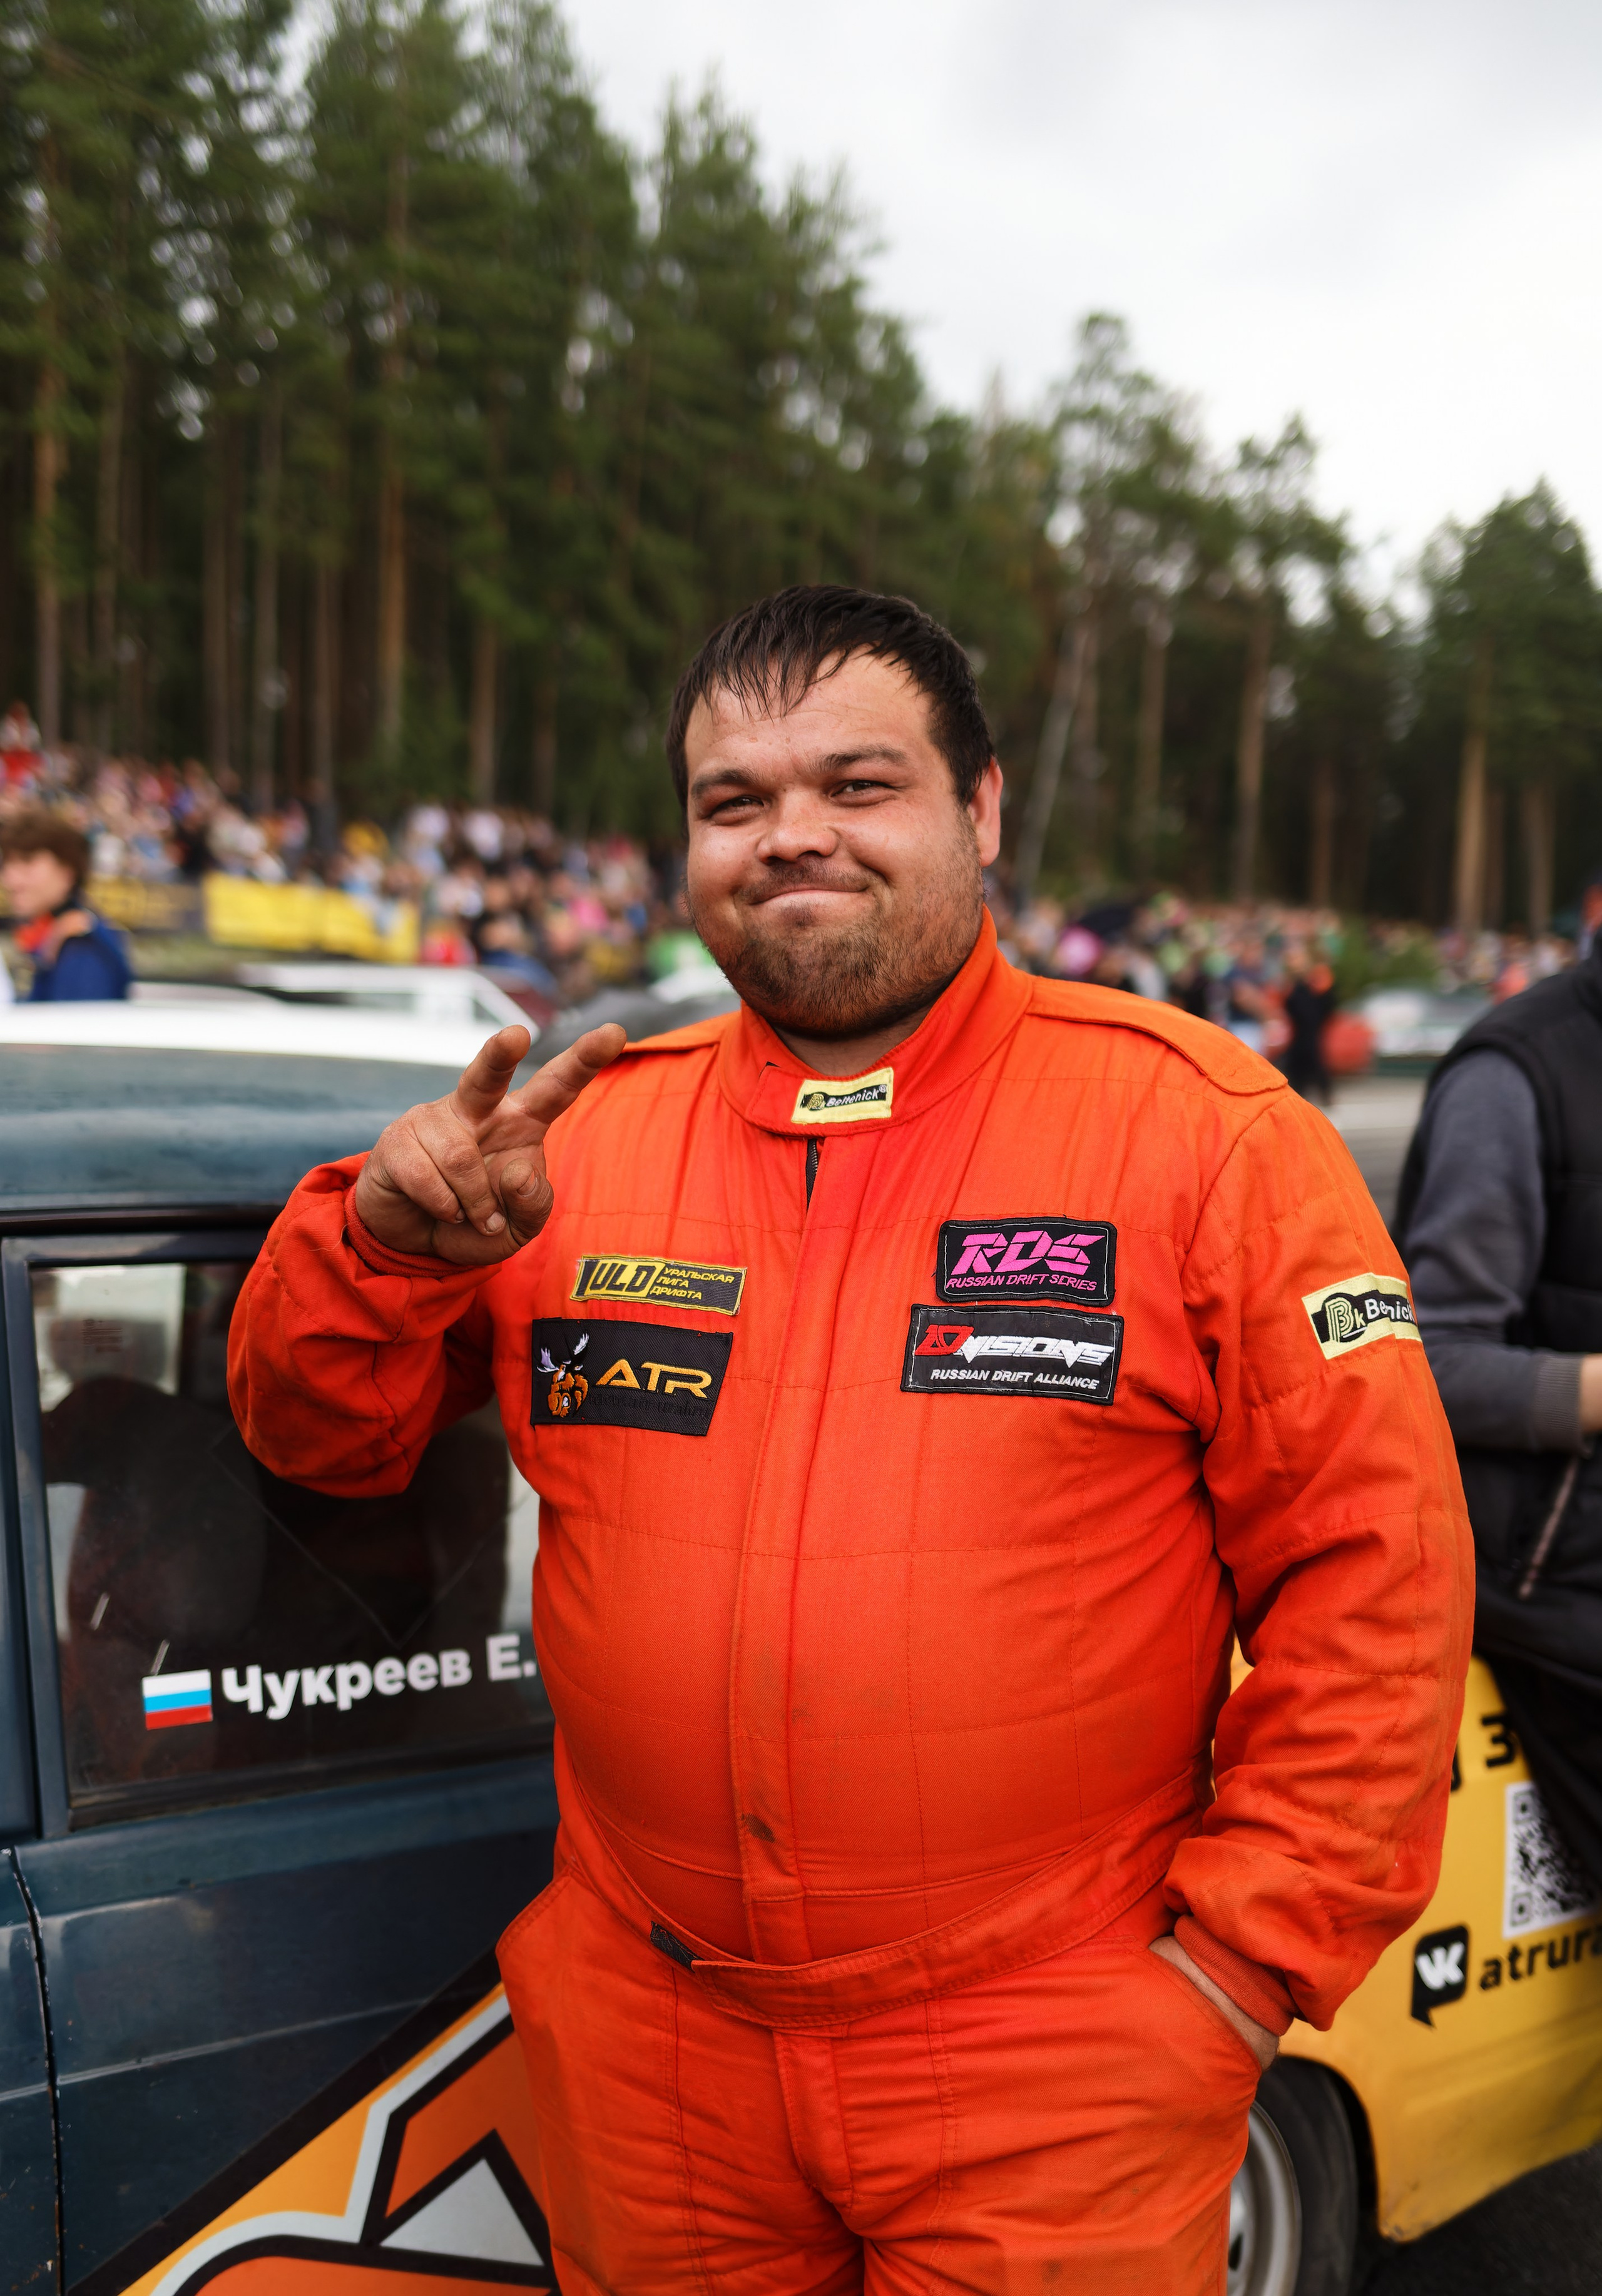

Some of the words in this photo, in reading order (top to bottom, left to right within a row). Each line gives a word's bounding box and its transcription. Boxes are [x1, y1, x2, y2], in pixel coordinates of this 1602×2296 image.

[951, 1230, 1106, 1276] RDS
[589, 1262, 658, 1293] ULD
[656, 1276, 690, 1288] ЛИГА
[663, 1267, 735, 1284] УРАЛЬСКАЯ
[946, 1275, 1005, 1289] RUSSIAN
[1006, 1274, 1049, 1286] DRIFT
[1049, 1274, 1098, 1291] SERIES
[650, 1286, 702, 1300] ДРИФТА
[594, 1359, 713, 1399] ATR
[930, 1368, 991, 1382] RUSSIAN
[991, 1370, 1034, 1384] DRIFT
[1034, 1373, 1100, 1391] ALLIANCE
[222, 1649, 472, 1720] Чукреев
[486, 1633, 538, 1682] Е.
